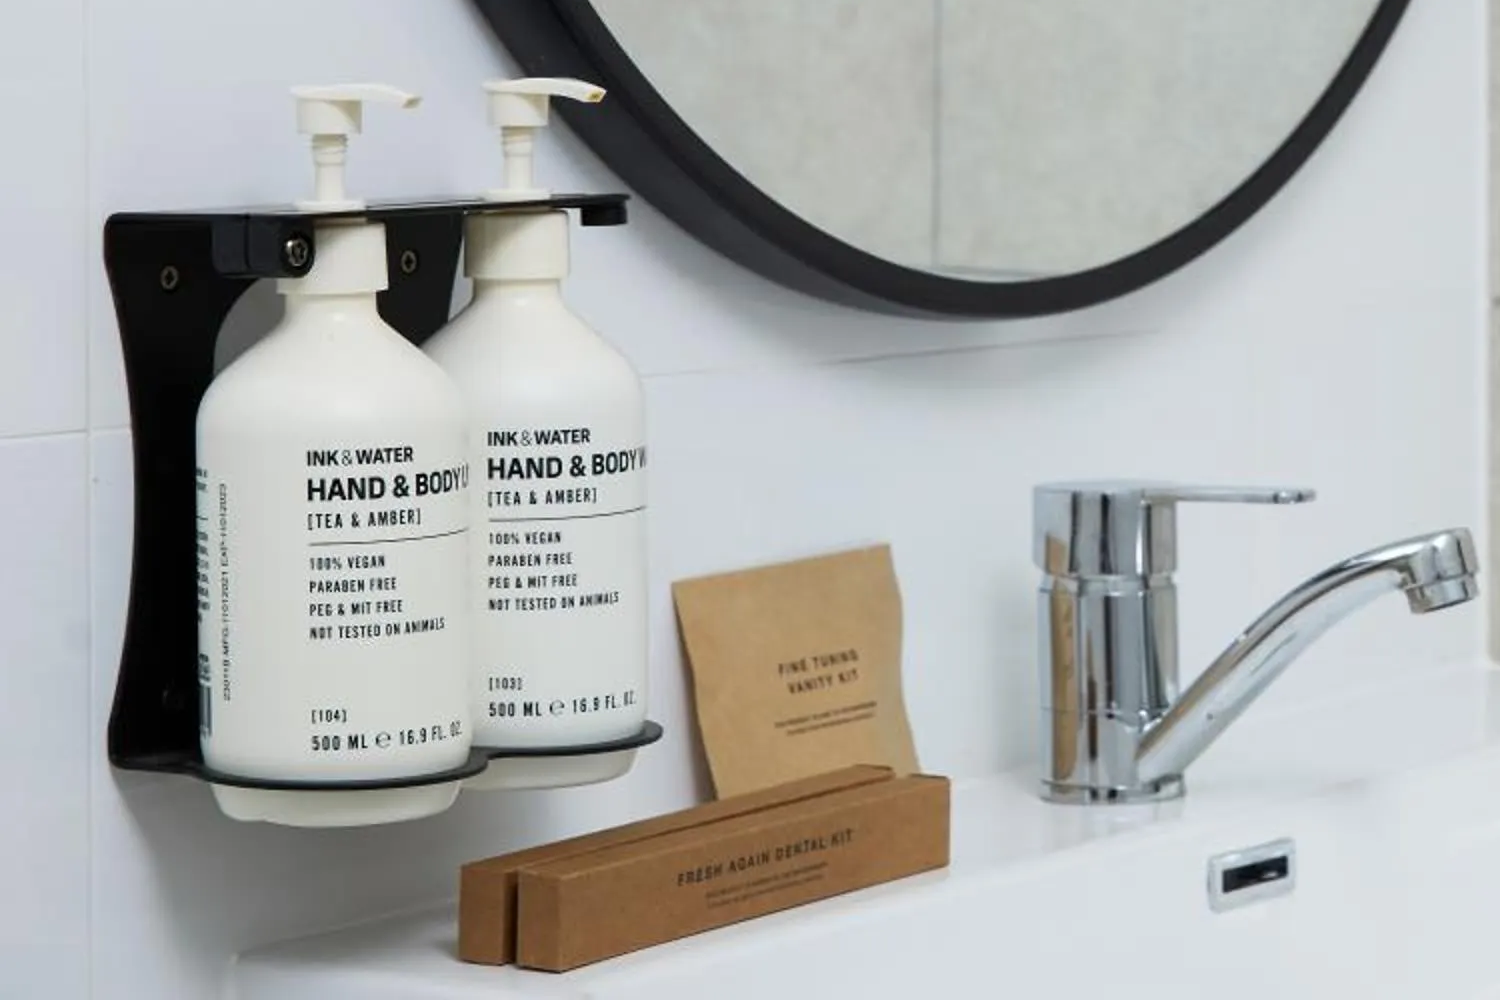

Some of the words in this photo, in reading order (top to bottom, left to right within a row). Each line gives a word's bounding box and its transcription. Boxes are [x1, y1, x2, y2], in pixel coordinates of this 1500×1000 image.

[488, 457, 562, 480] HAND
[570, 455, 586, 478] &
[592, 449, 636, 476] BODY
[308, 477, 386, 501] HAND
[392, 474, 409, 498] &
[416, 468, 460, 496] BODY
[488, 491, 521, 508] [TEA
[529, 490, 537, 504] &
[546, 488, 596, 504] AMBER]
[308, 513, 343, 530] [TEA
[351, 512, 360, 528] &
[368, 508, 420, 526] AMBER]
[490, 533, 520, 545] 100%
[525, 532, 561, 544] VEGAN
[310, 557, 342, 571] 100%
[348, 556, 385, 569] VEGAN
[488, 554, 541, 566] PARABEN
[546, 552, 572, 565] FREE
[310, 580, 364, 593] PARABEN
[370, 577, 396, 591] FREE
[488, 576, 510, 588] PEG
[515, 577, 522, 588] &
[528, 576, 547, 588] MIT
[552, 574, 576, 587] FREE
[310, 604, 333, 616] PEG
[338, 604, 345, 616] &
[351, 602, 371, 615] MIT
[376, 600, 402, 613] FREE
[489, 599, 510, 610] NOT
[515, 597, 556, 611] TESTED
[561, 596, 574, 608] ON
[580, 592, 619, 606] ANIMALS
[310, 626, 332, 639] NOT
[338, 624, 380, 638] TESTED
[386, 624, 400, 636] ON
[405, 618, 444, 633] ANIMALS
[788, 675, 832, 694] VANITY
[838, 667, 858, 683] KIT
[312, 709, 347, 724] [104]
[489, 702, 515, 717] 500
[523, 702, 542, 716] ML
[573, 697, 600, 714] 16.9
[312, 736, 340, 751] 500
[348, 734, 368, 749] ML
[400, 728, 426, 744] 16.9
[677, 863, 723, 887] FRESH
[728, 851, 770, 872] AGAIN
[775, 838, 827, 862] DENTAL
[831, 828, 853, 847] KIT
